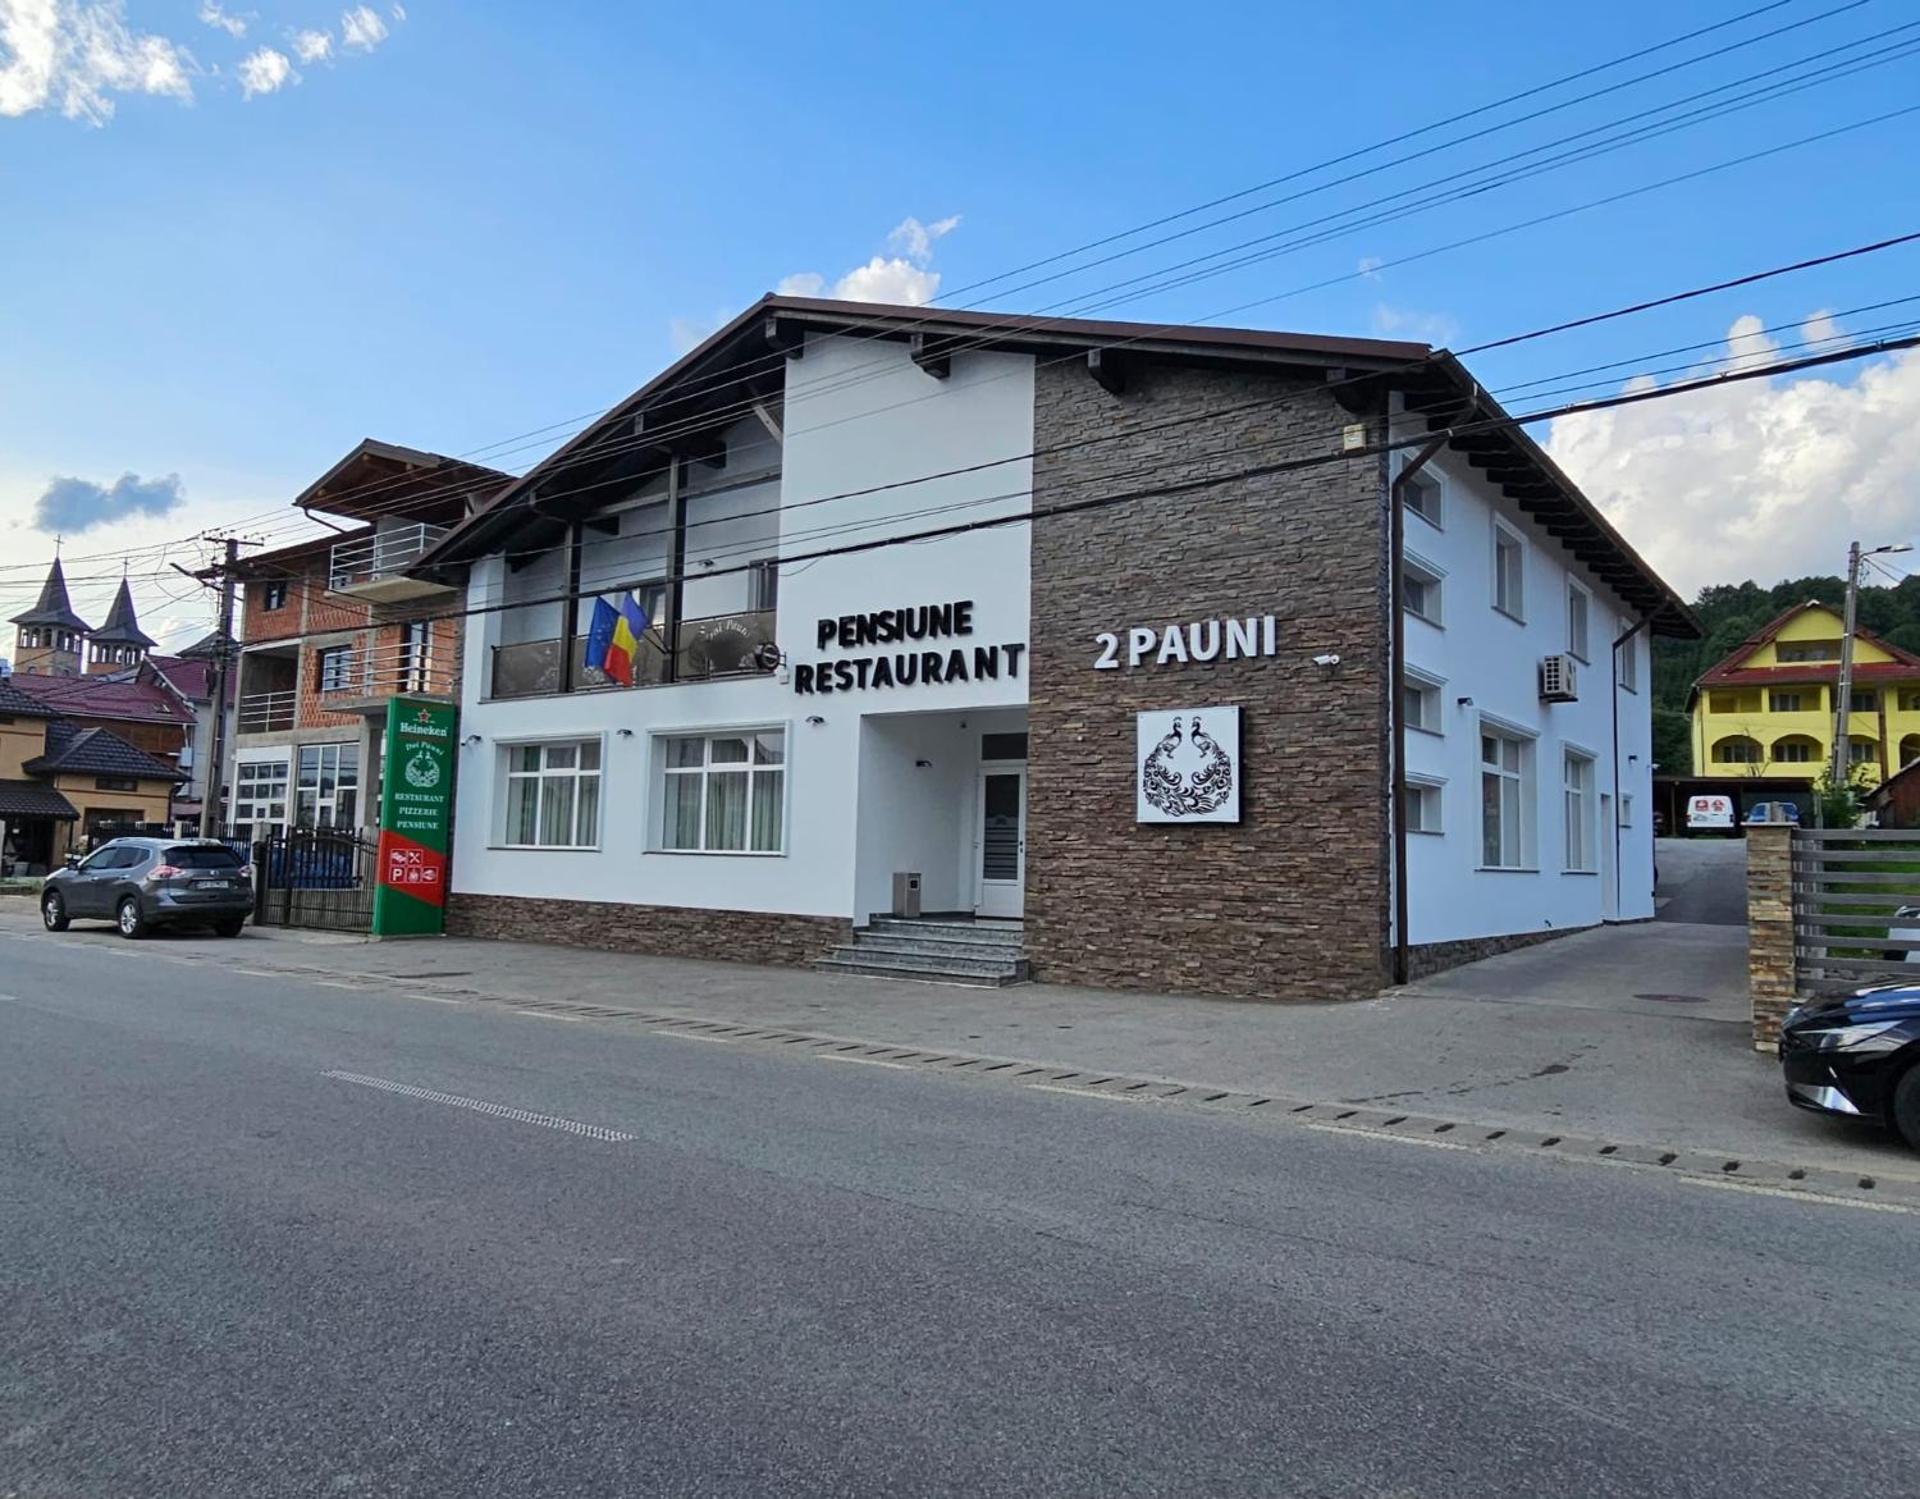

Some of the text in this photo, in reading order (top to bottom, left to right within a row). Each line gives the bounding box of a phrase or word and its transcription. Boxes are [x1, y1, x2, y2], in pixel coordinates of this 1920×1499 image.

[817, 600, 973, 650] PENSIUNE
[1094, 615, 1277, 669] 2 PAUNI
[794, 643, 1026, 695] RESTAURANT
[400, 722, 447, 737] Heineken
[395, 792, 445, 803] RESTAURANT
[399, 807, 439, 816] PIZZERIE
[397, 821, 439, 830] PENSIUNE
[392, 868, 403, 881] P
